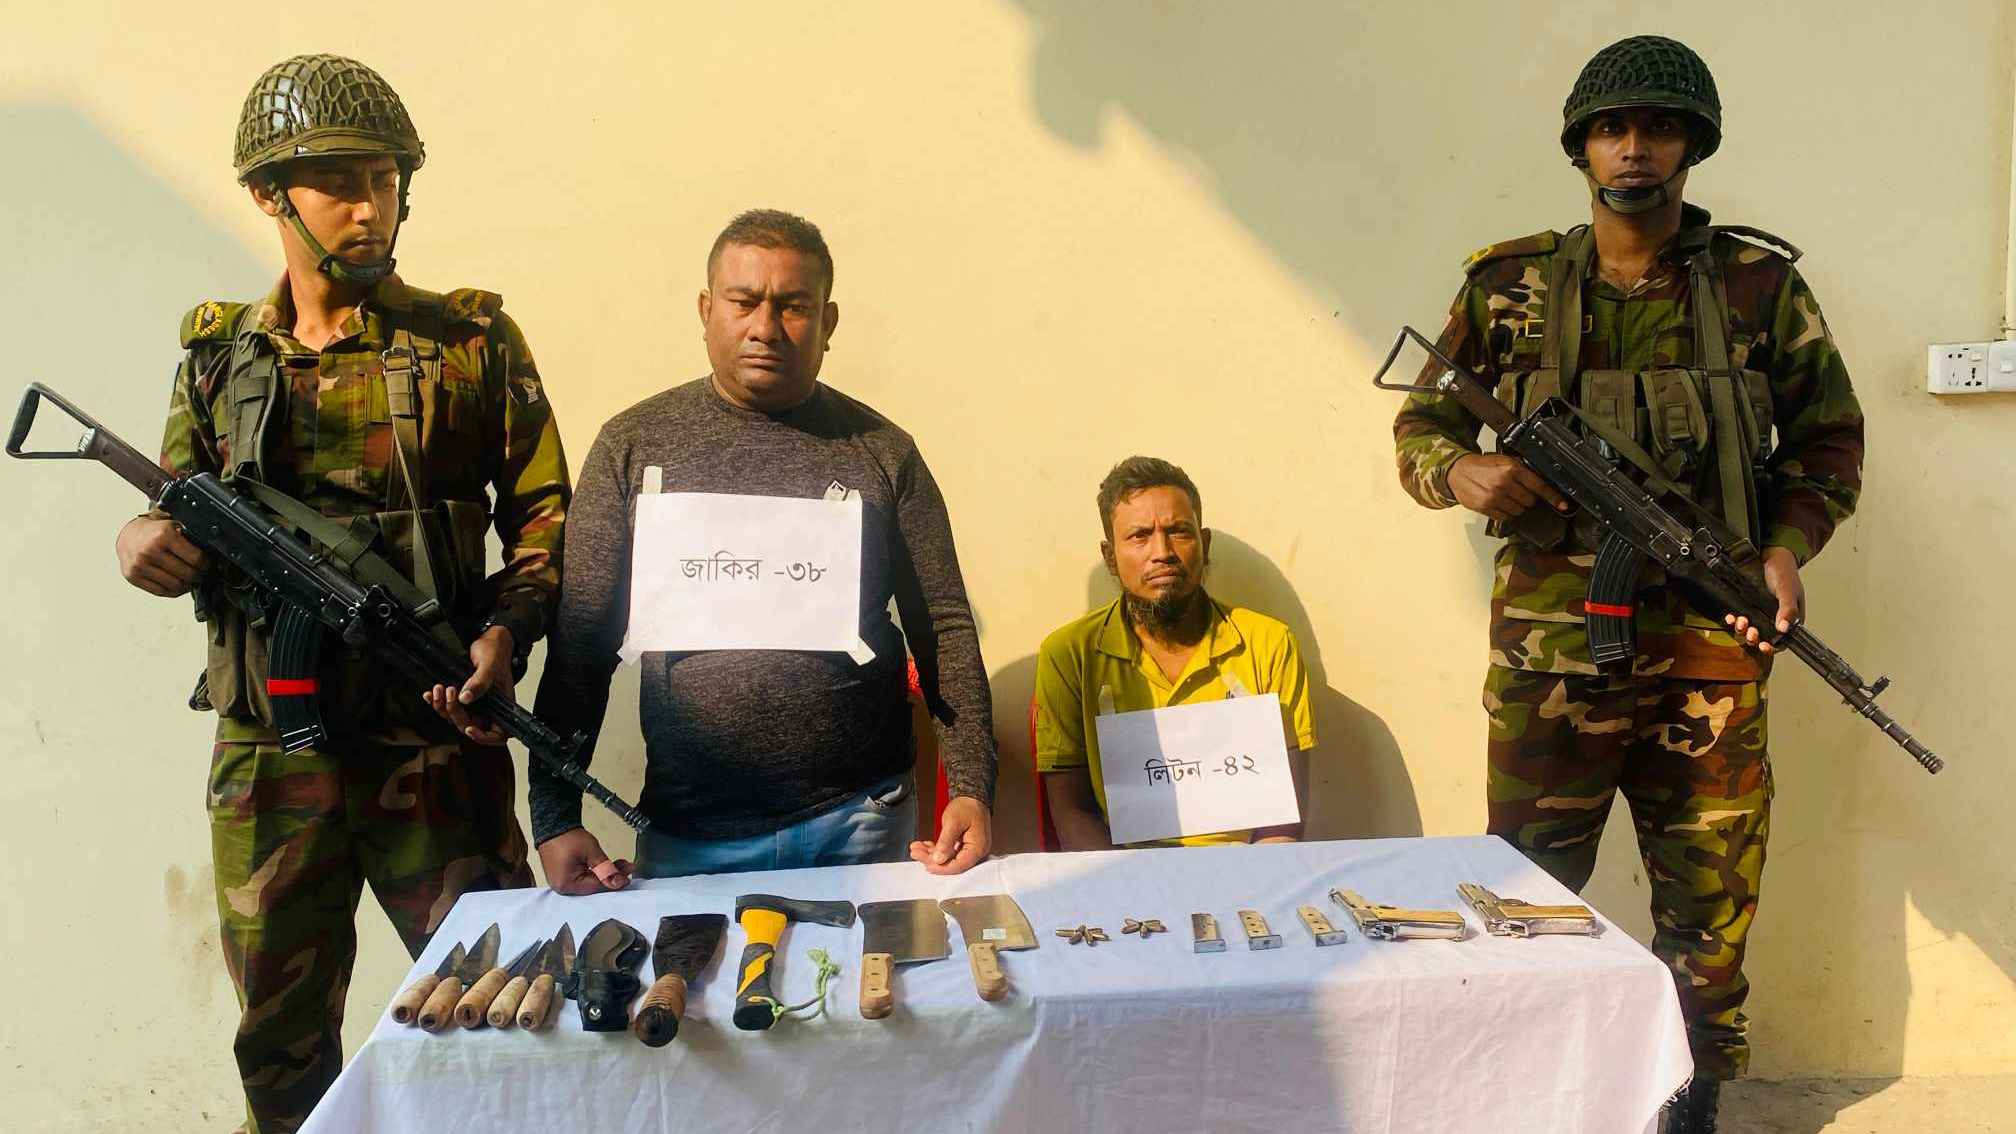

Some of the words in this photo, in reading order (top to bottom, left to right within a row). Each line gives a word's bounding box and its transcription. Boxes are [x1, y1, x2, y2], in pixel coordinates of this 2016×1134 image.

[679, 550, 763, 582] জাকির
[773, 560, 827, 582] -৩৮
[1144, 758, 1202, 787] লিটন
[1212, 755, 1261, 777] -৪২
